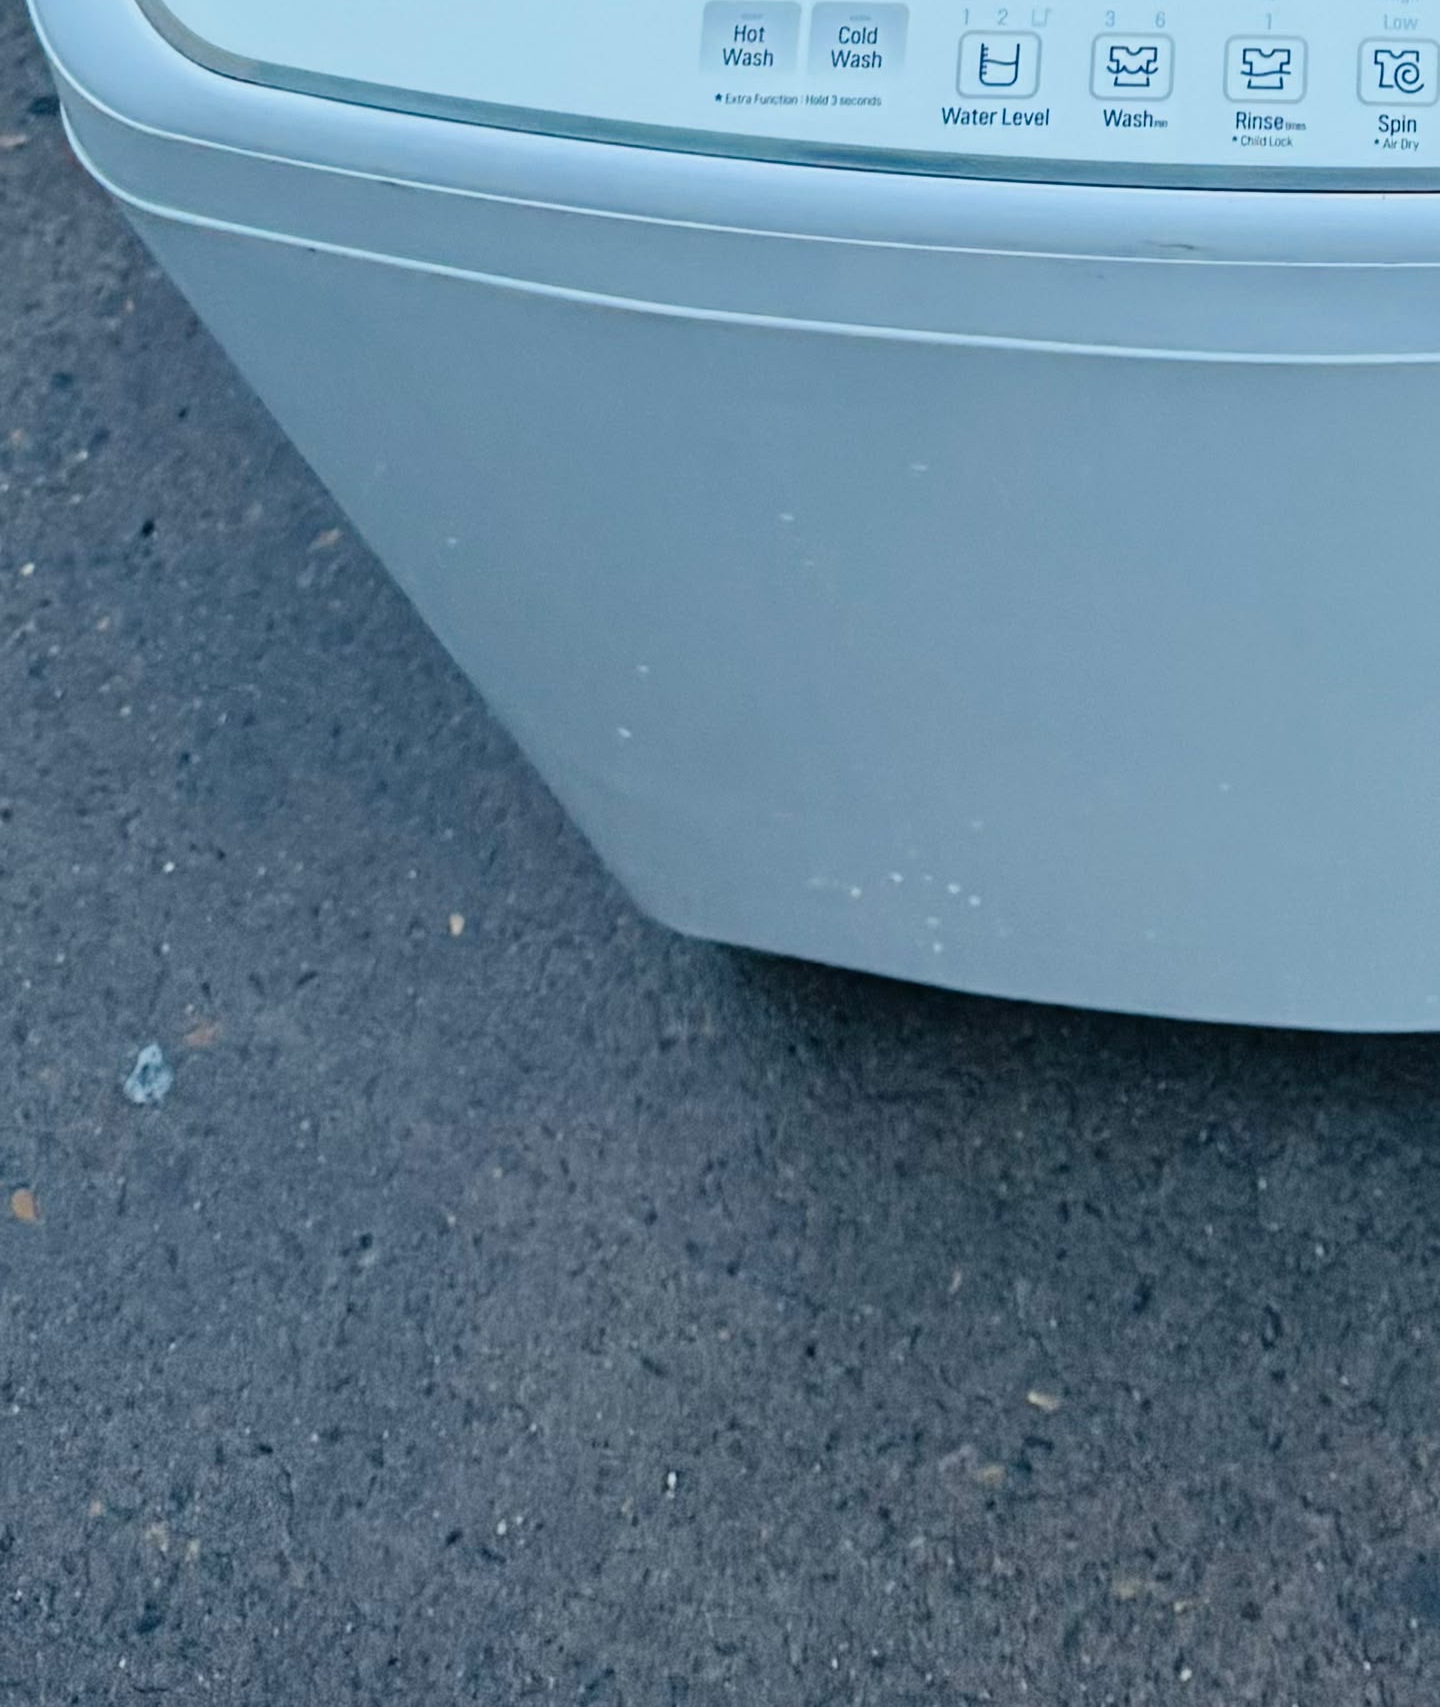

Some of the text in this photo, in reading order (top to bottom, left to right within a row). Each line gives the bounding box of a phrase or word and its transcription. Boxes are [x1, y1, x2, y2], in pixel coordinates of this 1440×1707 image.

[997, 9, 1008, 26] 2
[1105, 10, 1115, 27] 3
[1155, 11, 1166, 28] 6
[1383, 14, 1418, 30] Low
[733, 25, 765, 43] Hot
[838, 26, 878, 46] Cold
[722, 48, 774, 68] Wash
[831, 50, 883, 69] Wash
[725, 93, 751, 104] Extra
[754, 93, 798, 106] Function
[806, 94, 829, 106] Hold
[839, 95, 882, 107] seconds
[942, 107, 1050, 126] Water Level
[1103, 109, 1152, 128] Wash
[1235, 111, 1284, 130] Rinse
[1378, 113, 1417, 136] Spin
[1240, 134, 1294, 147] Child Lock
[1382, 138, 1420, 151] Air Dry
